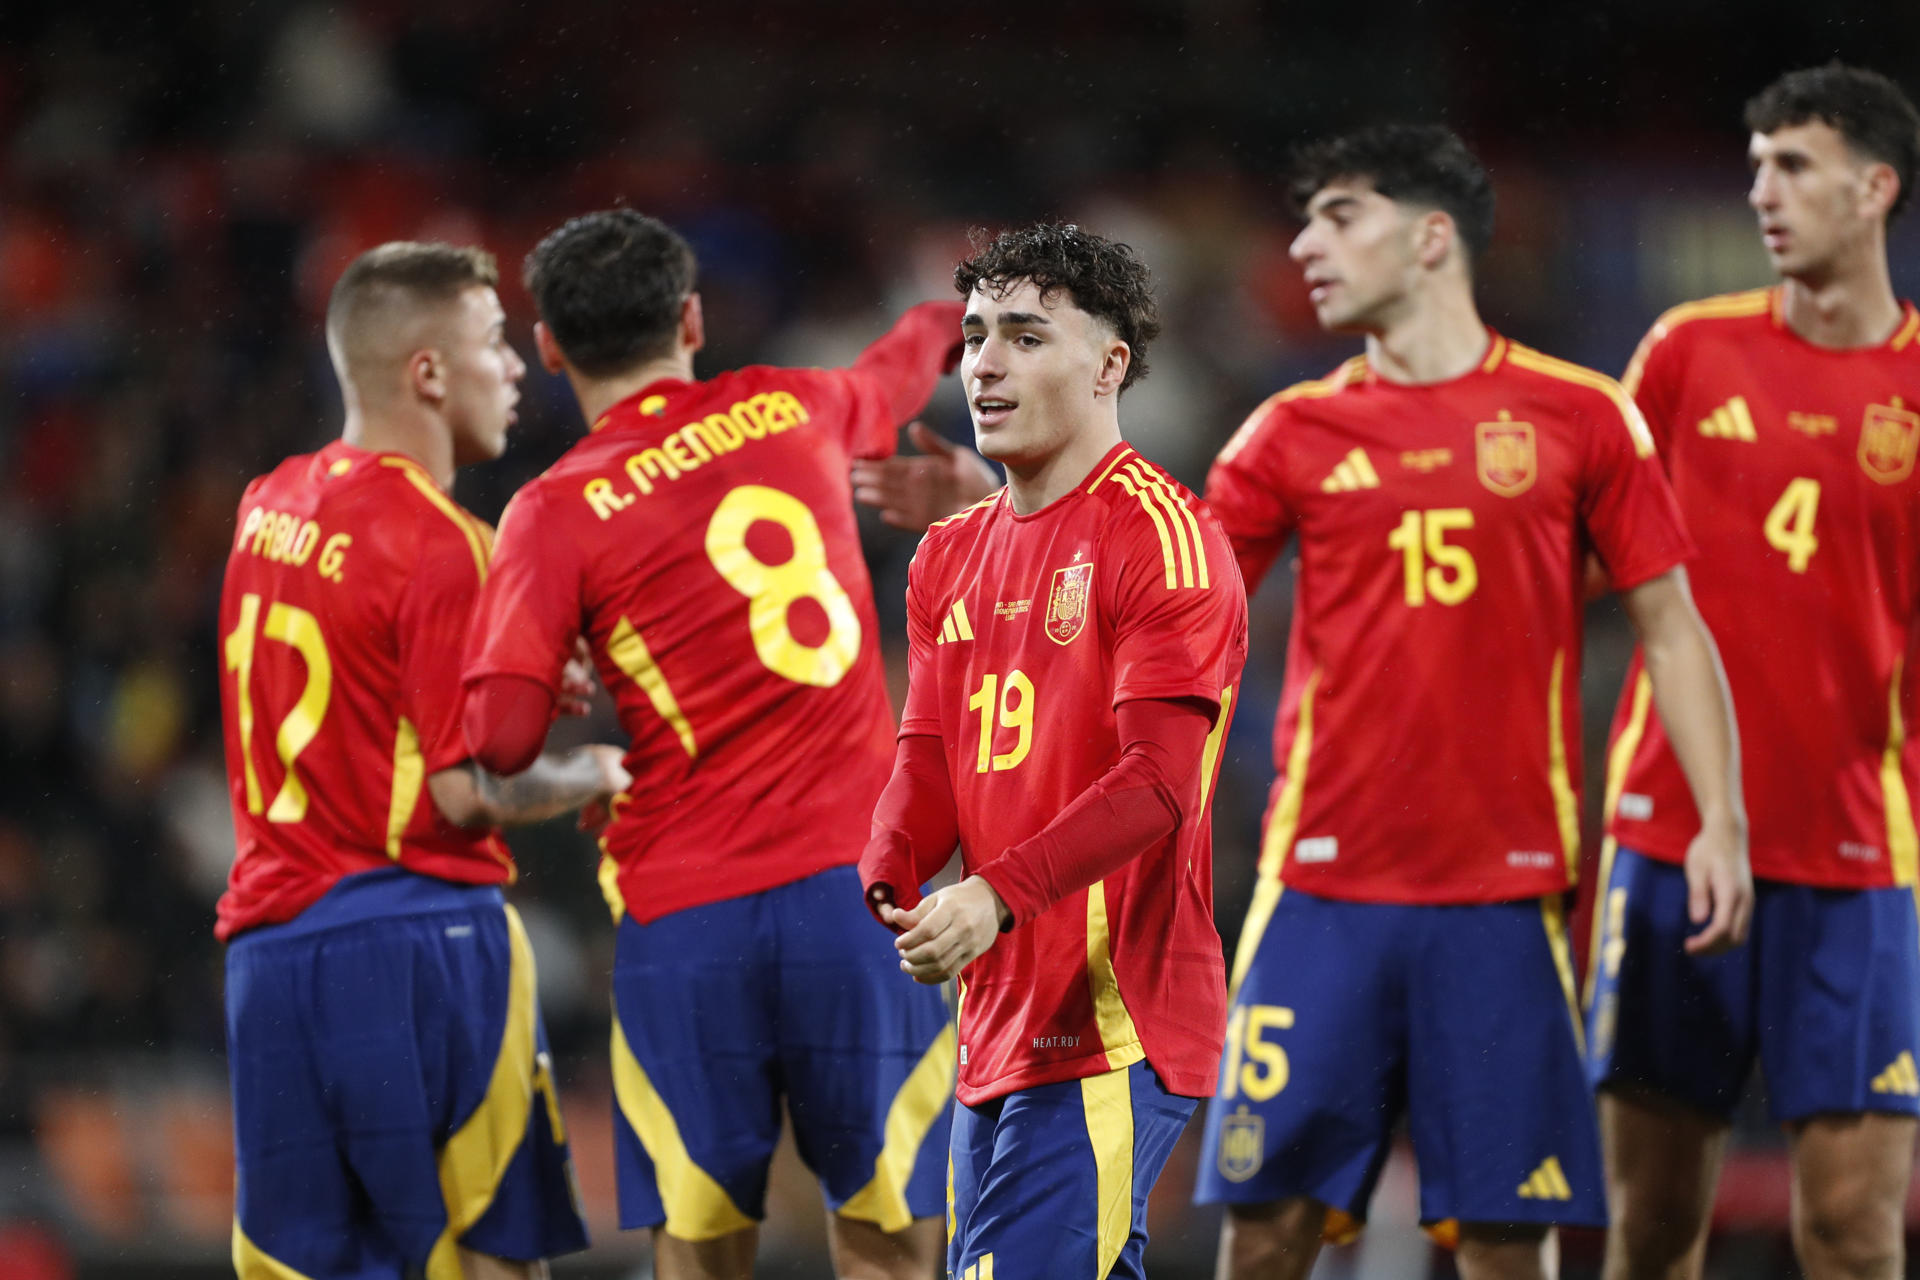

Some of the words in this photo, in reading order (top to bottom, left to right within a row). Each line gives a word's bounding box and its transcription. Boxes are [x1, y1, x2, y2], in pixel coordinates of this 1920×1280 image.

[583, 477, 635, 521] R.
[624, 391, 810, 495] MENDOZA
[237, 505, 320, 568] PABLO
[318, 532, 353, 584] G.
[1388, 507, 1478, 607] 15
[1763, 476, 1821, 574] 4
[705, 484, 861, 687] 8
[969, 669, 1035, 774] 19
[1033, 1036, 1080, 1048] HEAT.RDY
[1222, 1004, 1295, 1102] 15
